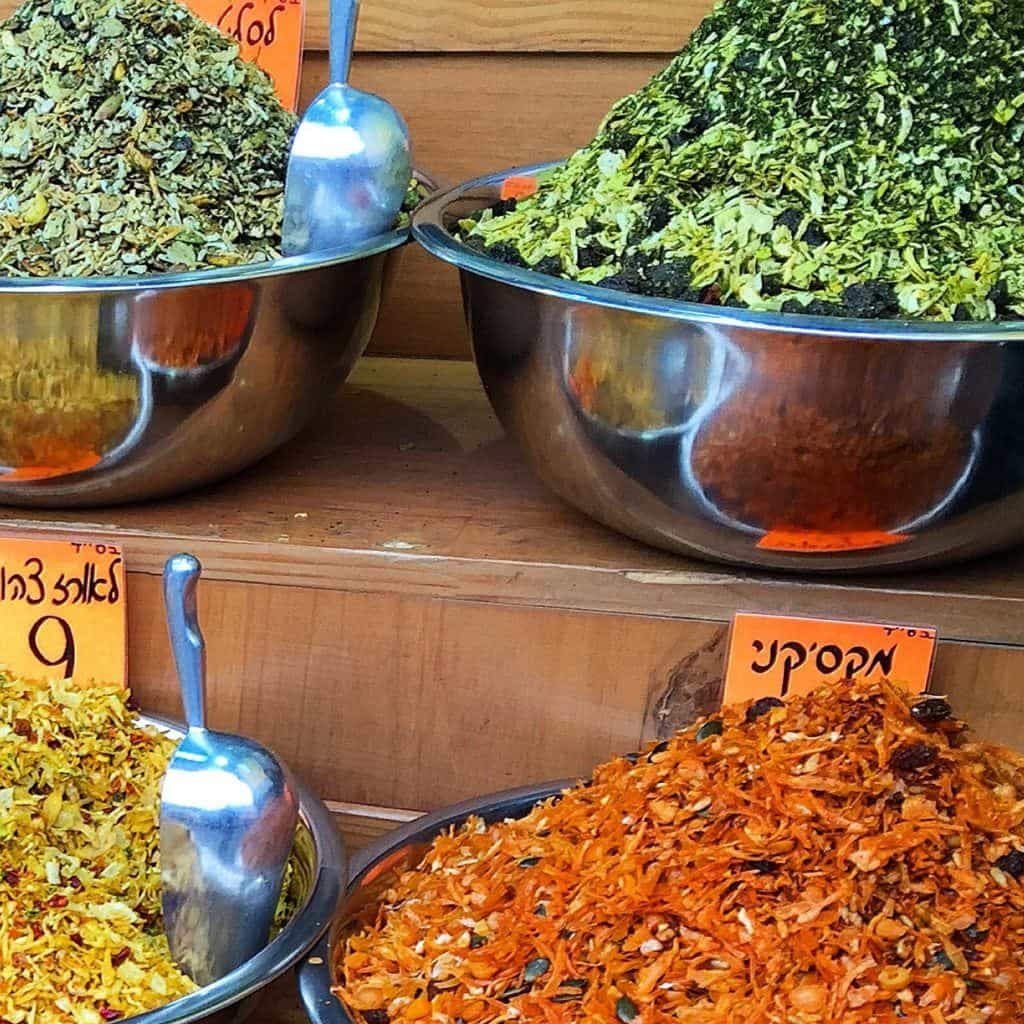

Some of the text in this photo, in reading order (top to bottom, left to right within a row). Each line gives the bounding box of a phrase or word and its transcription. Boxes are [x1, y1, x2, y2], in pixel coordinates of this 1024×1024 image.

[51, 557, 122, 606] לאורז
[28, 615, 75, 679] 9
[750, 639, 898, 697] מקסיקני
